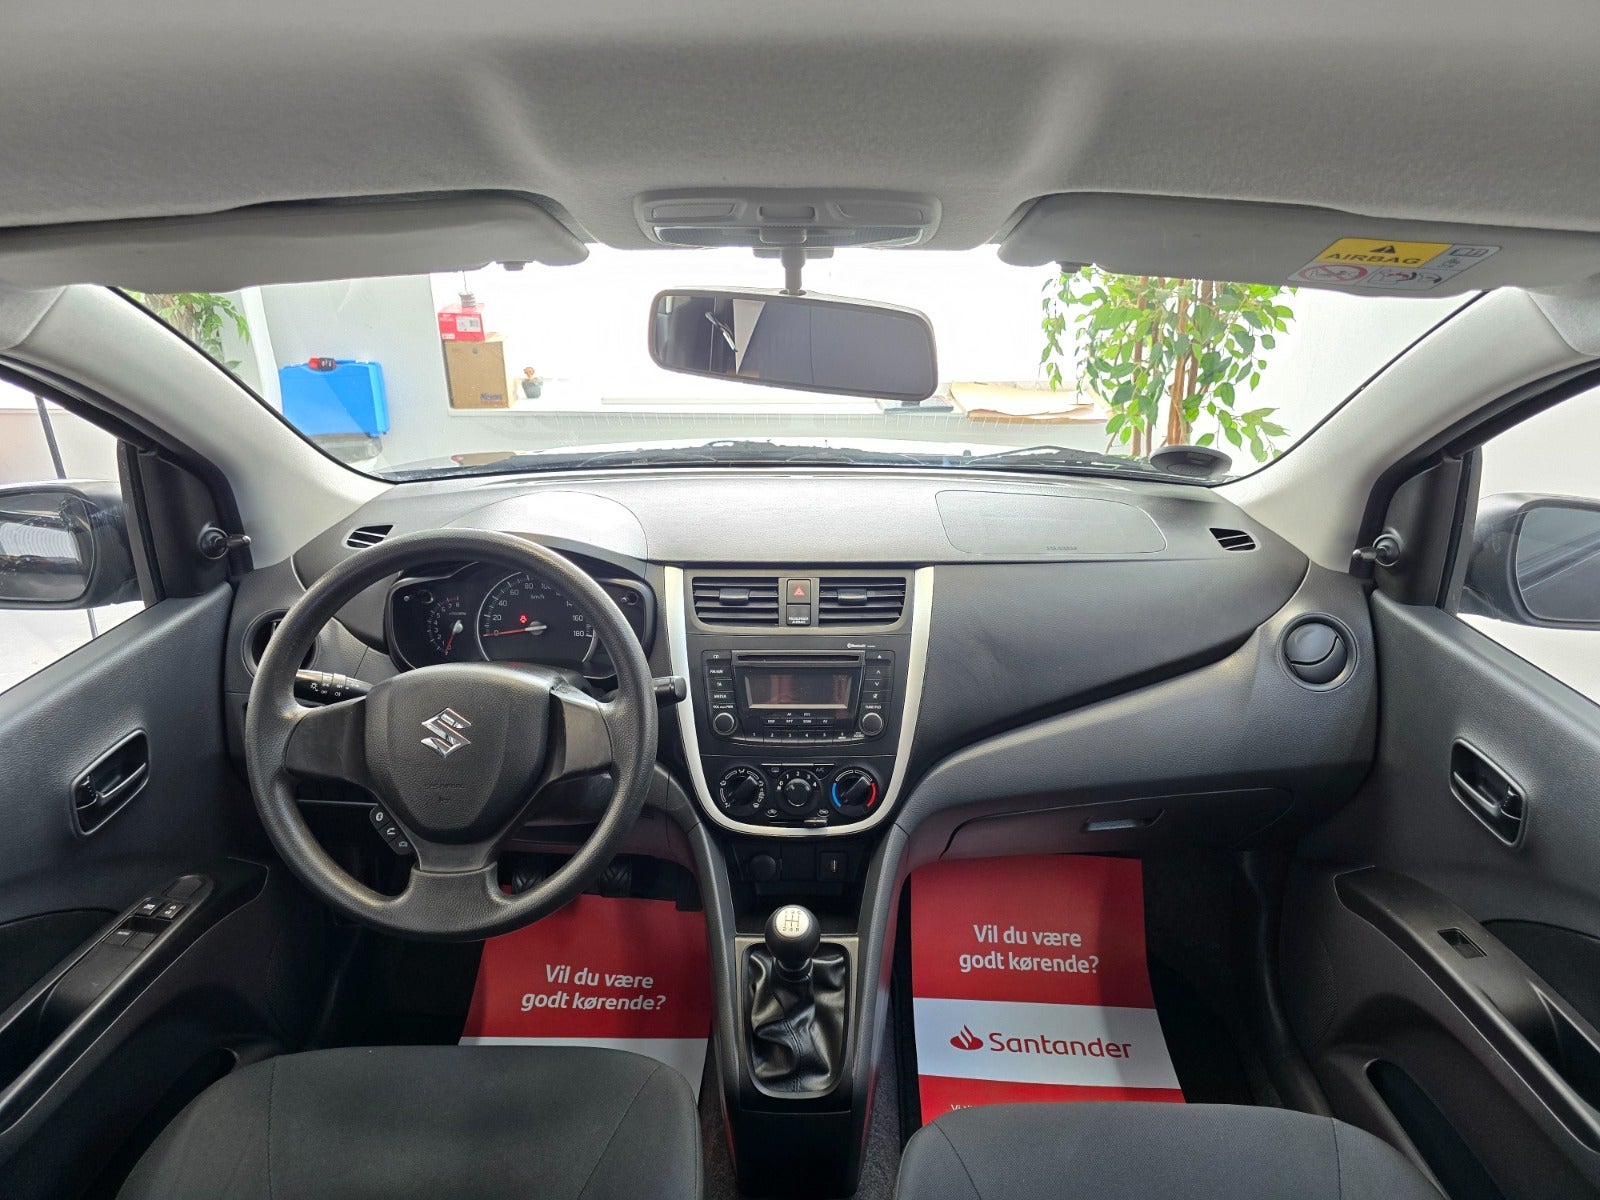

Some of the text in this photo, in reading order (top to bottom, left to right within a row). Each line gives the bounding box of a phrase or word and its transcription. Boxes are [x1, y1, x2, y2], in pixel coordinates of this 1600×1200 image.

[1326, 253, 1421, 265] AIRBAG
[524, 582, 534, 590] 80
[973, 924, 1082, 947] Vil du være
[959, 951, 1100, 974] godt kørende?
[545, 964, 654, 989] Vil du være
[520, 991, 667, 1012] godt kørende?
[988, 1032, 1132, 1059] Santander
